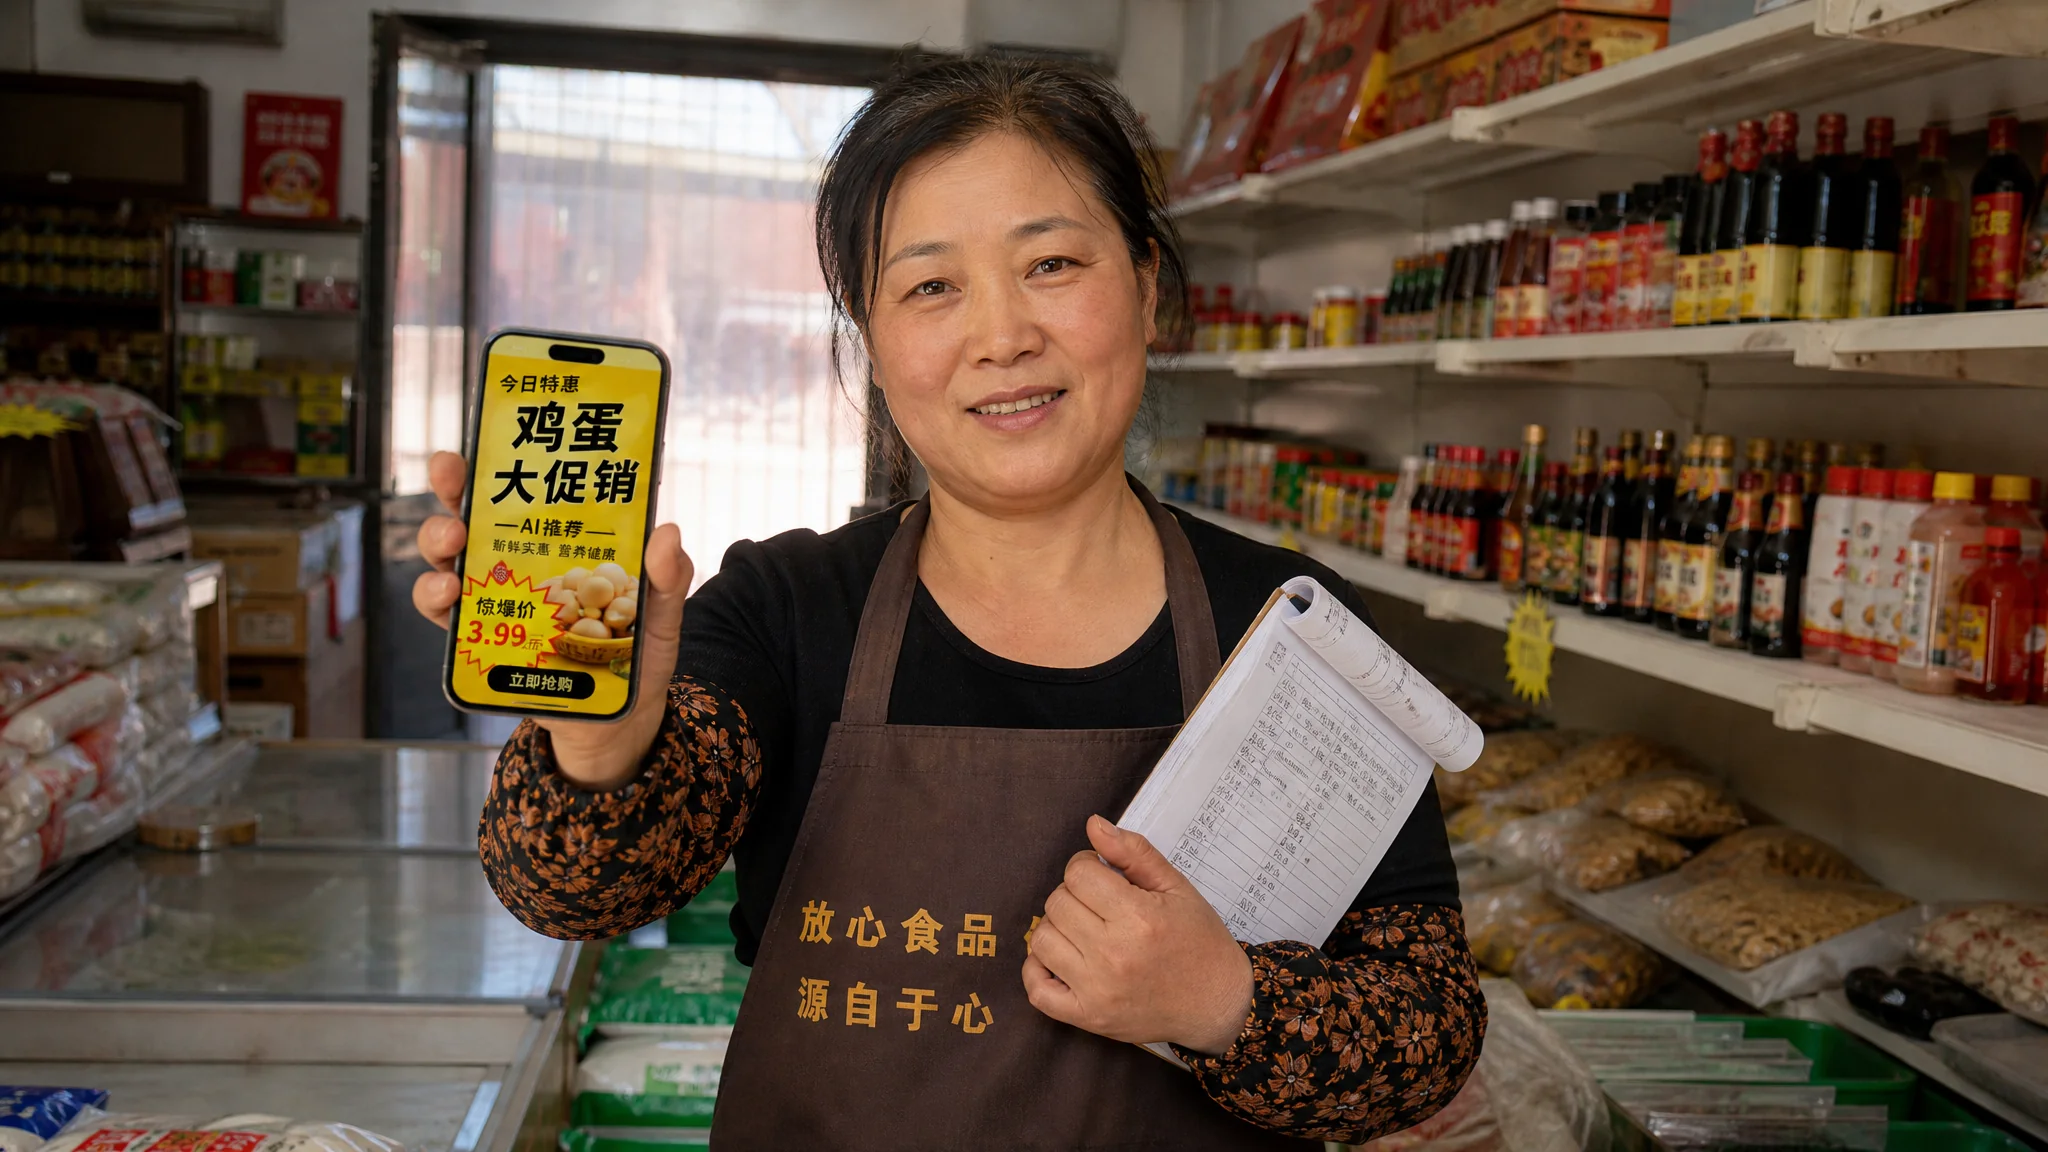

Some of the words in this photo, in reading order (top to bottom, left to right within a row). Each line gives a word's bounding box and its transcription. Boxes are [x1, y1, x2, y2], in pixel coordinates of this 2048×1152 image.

[500, 374, 580, 393] 今日特惠
[511, 400, 624, 453] 鸡蛋
[490, 459, 640, 505] 大促销
[476, 597, 536, 619] 惊爆价
[466, 620, 526, 647] 3.99
[509, 672, 573, 693] 立即抢购
[797, 976, 994, 1034] 源自于心
